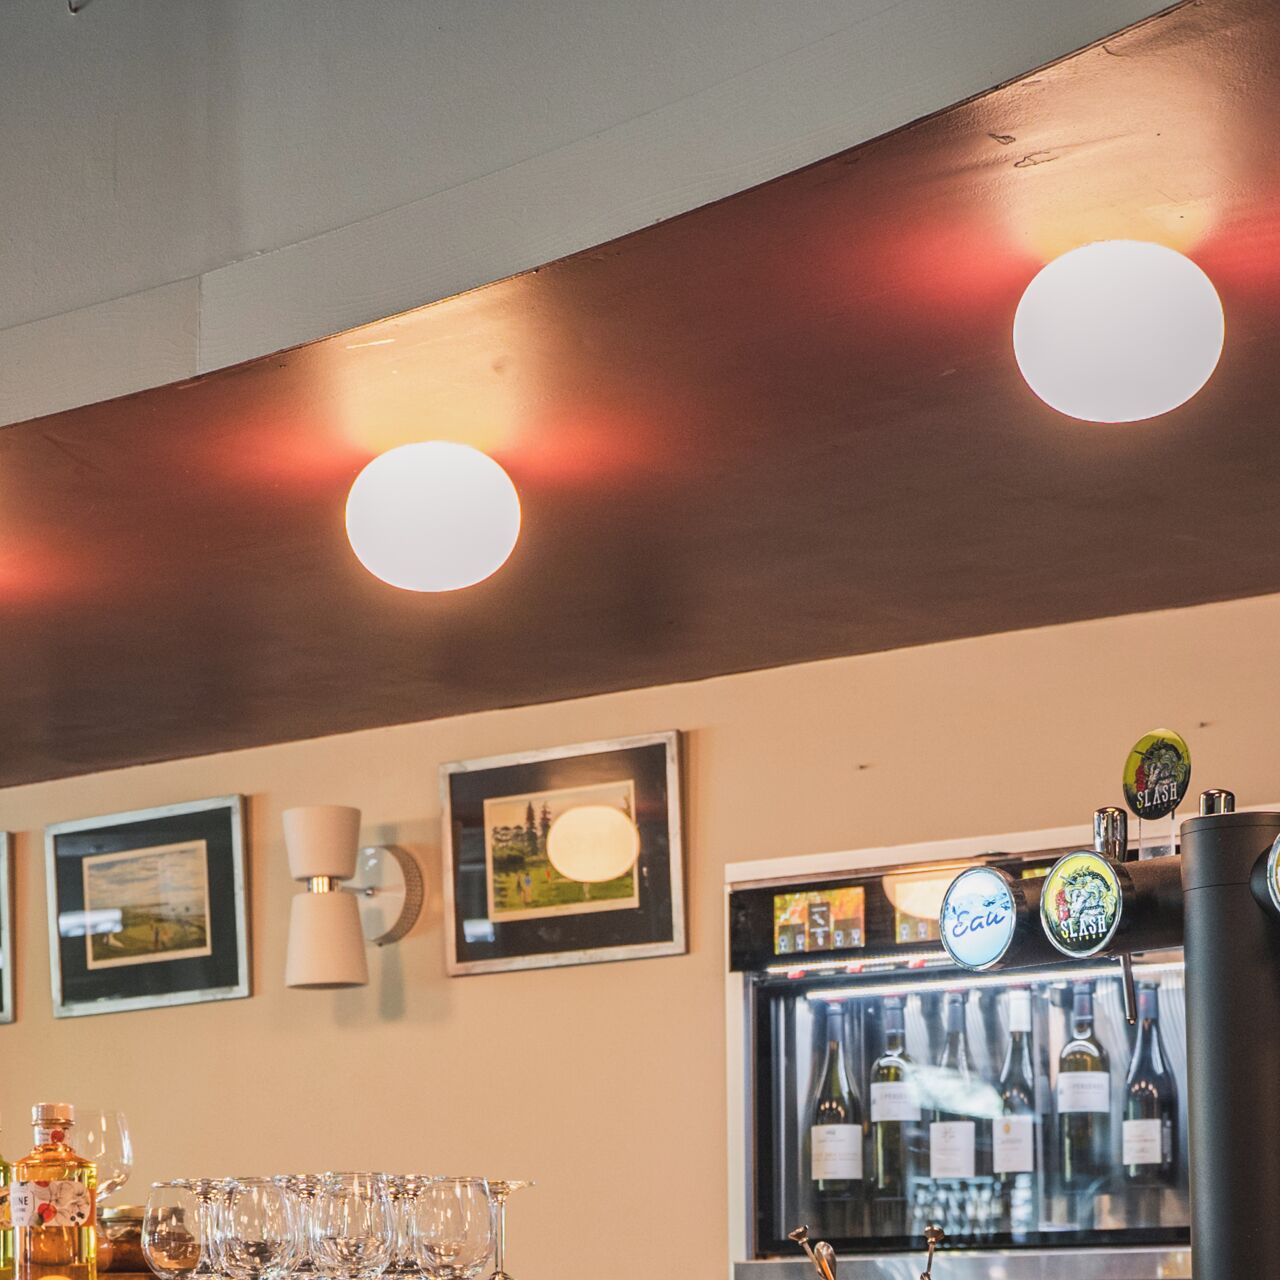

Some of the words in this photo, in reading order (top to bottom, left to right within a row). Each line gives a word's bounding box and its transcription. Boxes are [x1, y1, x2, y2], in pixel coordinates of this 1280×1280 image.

[1136, 782, 1177, 809] SLASH
[952, 911, 1006, 938] Eau
[1061, 914, 1107, 939] SLASH
